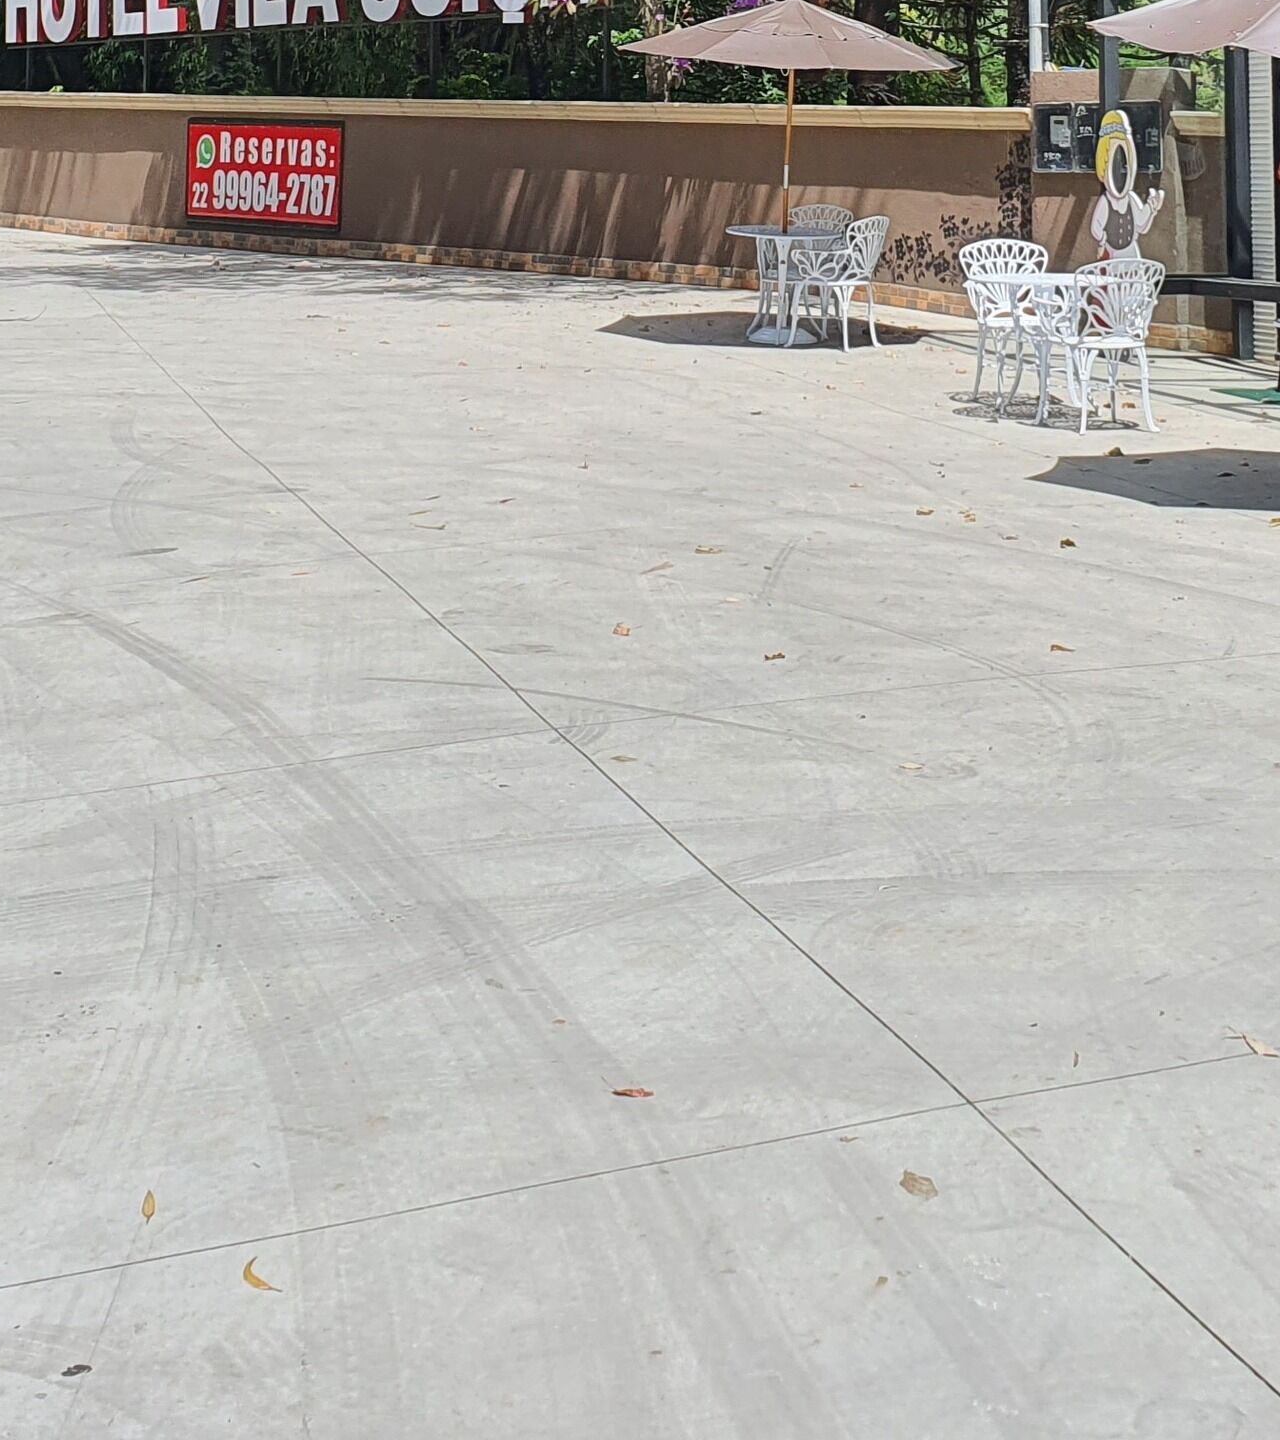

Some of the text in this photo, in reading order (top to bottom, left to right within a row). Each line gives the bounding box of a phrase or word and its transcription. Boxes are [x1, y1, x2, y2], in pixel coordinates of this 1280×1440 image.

[220, 131, 336, 168] Reservas:
[192, 169, 336, 216] 22 99964-2787
